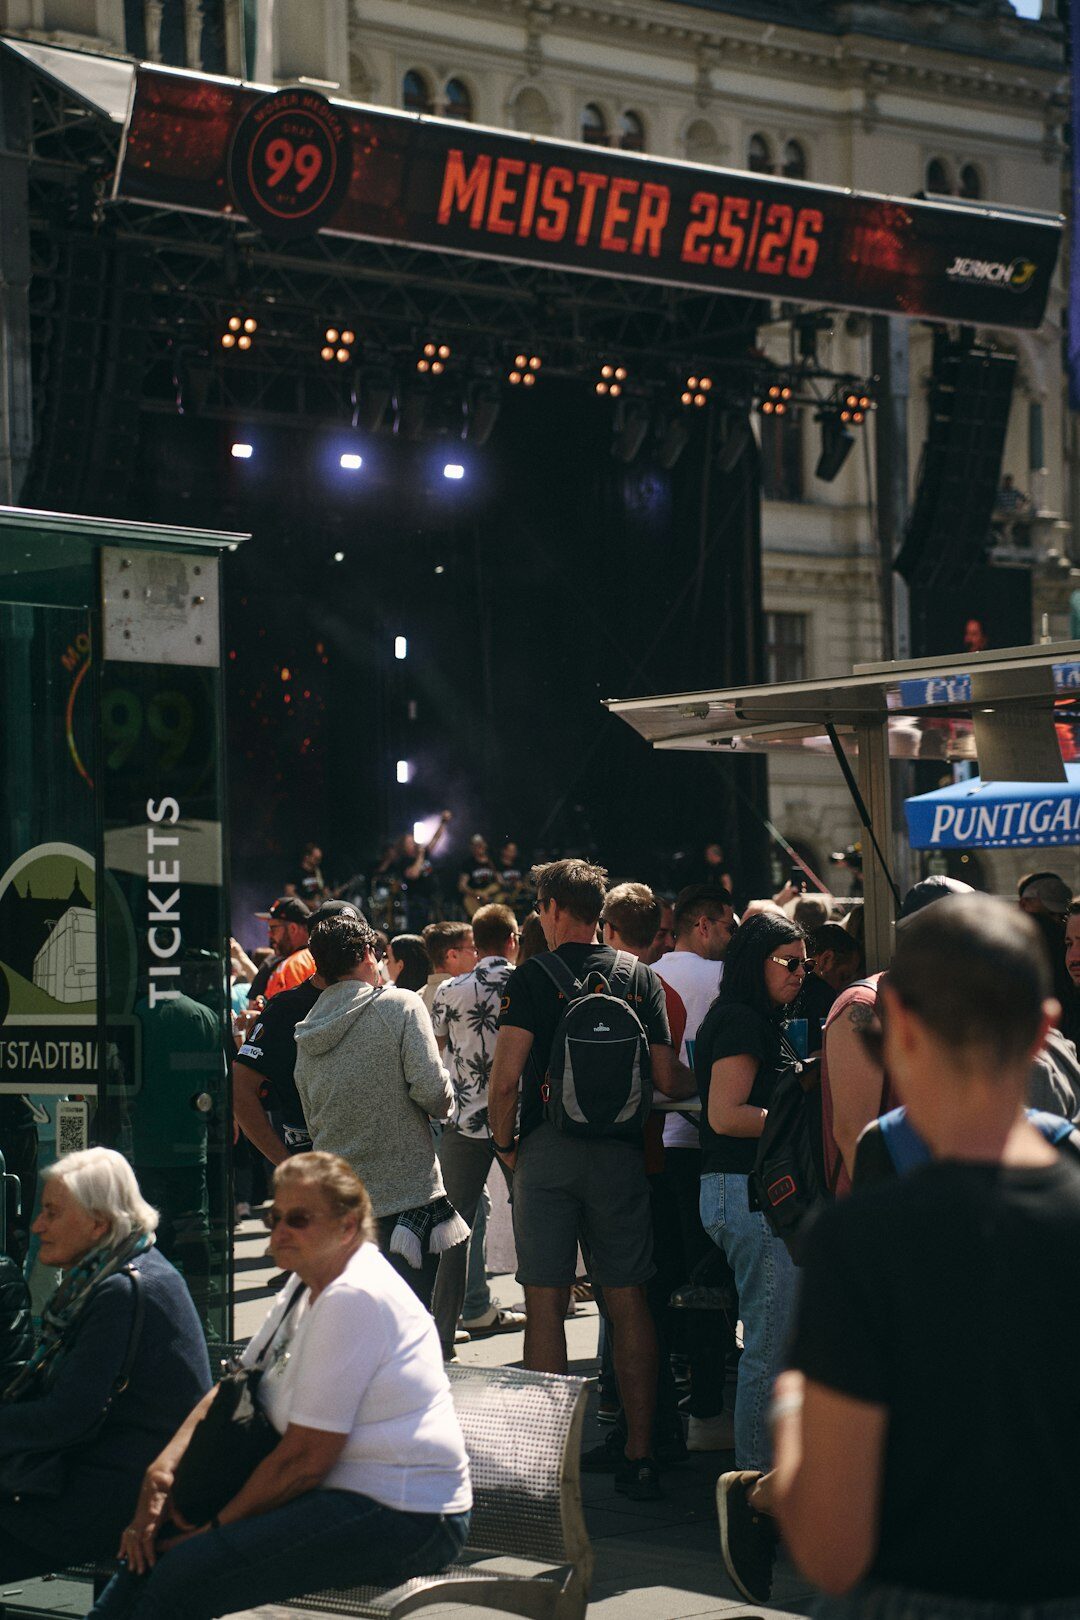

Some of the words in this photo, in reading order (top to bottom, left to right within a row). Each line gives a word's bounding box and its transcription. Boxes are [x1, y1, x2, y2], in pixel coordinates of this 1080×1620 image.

[264, 138, 323, 192] 99
[437, 149, 671, 257] MEISTER
[147, 796, 181, 1009] TICKETS
